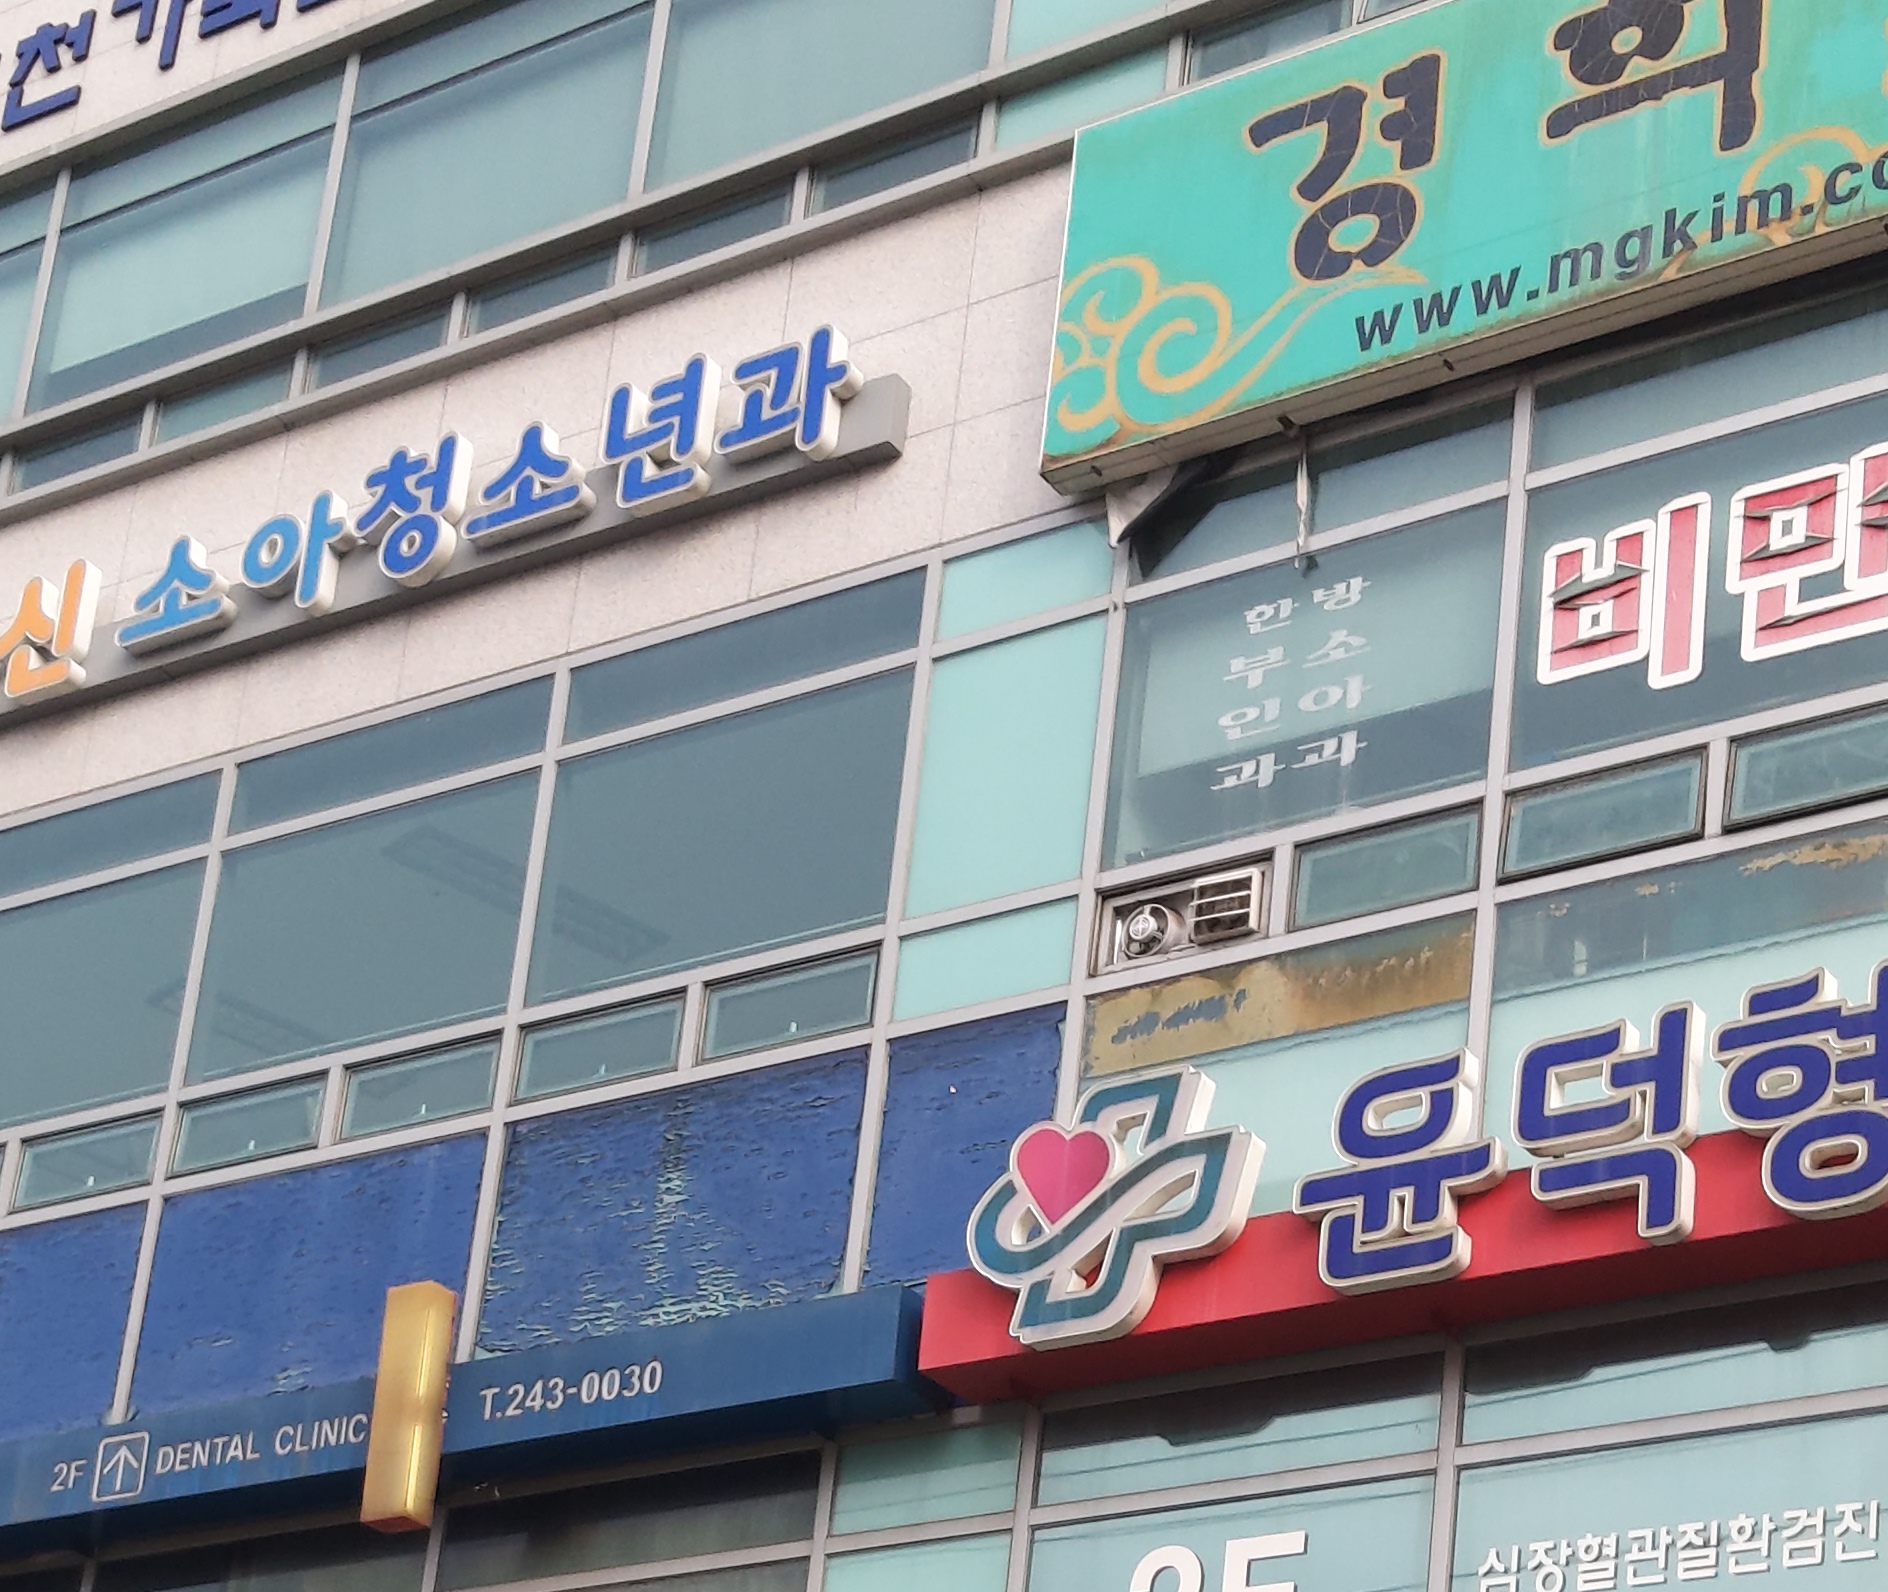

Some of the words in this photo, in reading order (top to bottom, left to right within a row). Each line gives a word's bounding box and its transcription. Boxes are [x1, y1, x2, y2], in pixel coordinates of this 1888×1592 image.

[114, 322, 864, 654] 소아청소년과
[50, 1458, 88, 1493] 2F
[154, 1431, 261, 1475] DENTAL
[274, 1412, 369, 1456] CLINIC
[479, 1358, 663, 1421] T.243-0030
